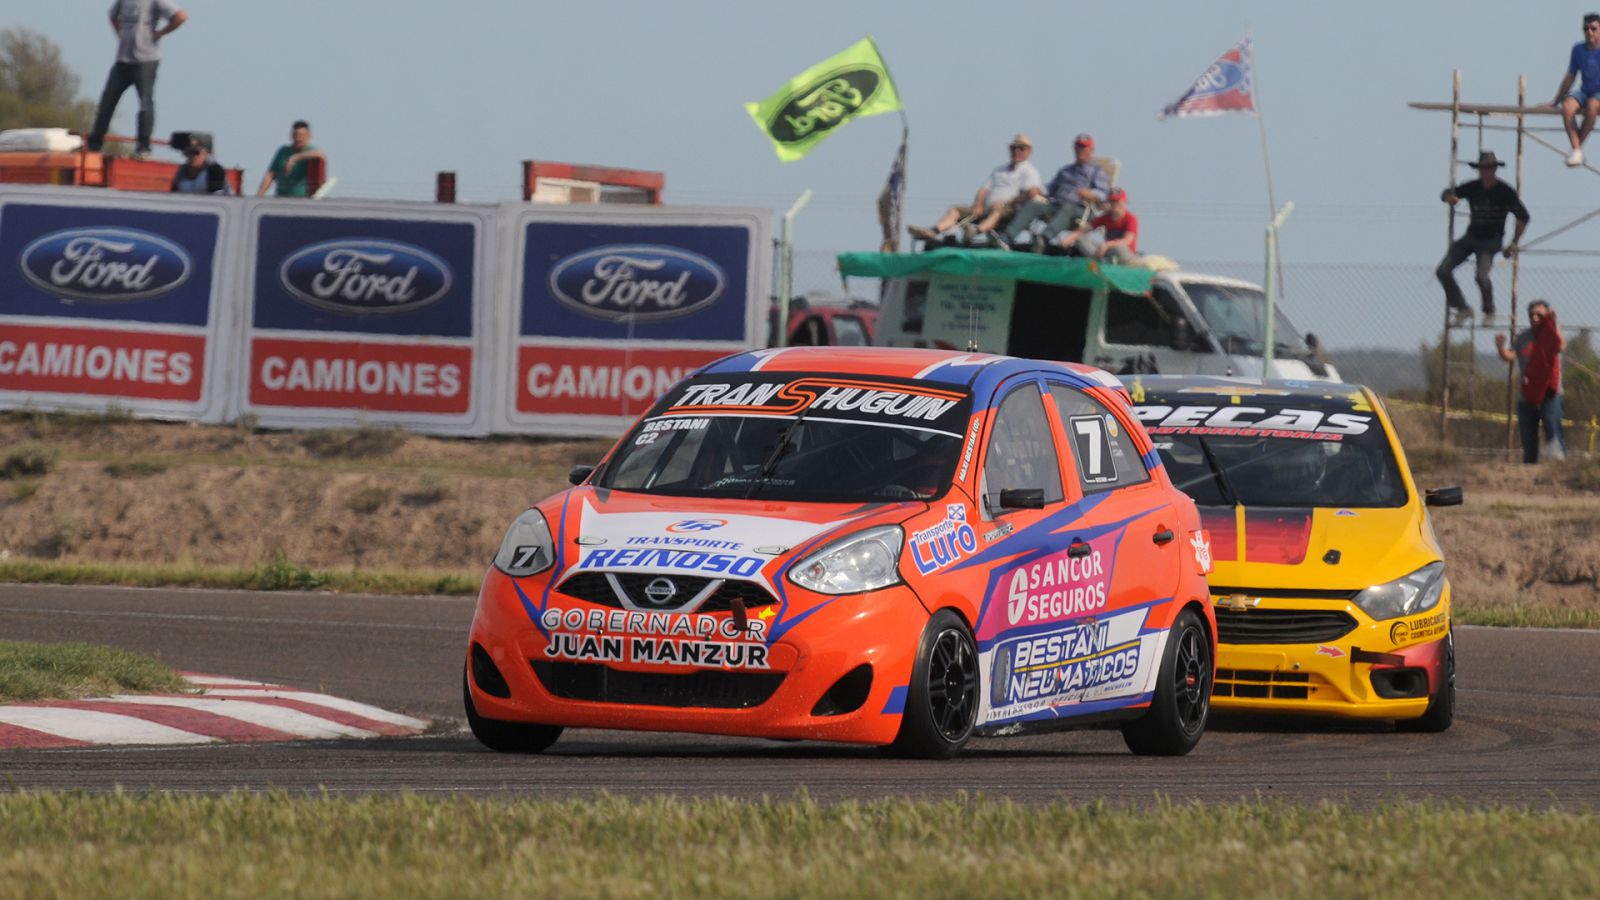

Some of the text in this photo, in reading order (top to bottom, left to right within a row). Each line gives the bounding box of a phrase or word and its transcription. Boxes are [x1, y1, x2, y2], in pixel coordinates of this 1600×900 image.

[52, 236, 159, 289] Ford
[312, 248, 419, 301] Ford
[582, 255, 692, 307] Ford
[0, 340, 192, 385] CAMIONES
[261, 356, 461, 397] CAMIONES
[527, 362, 692, 399] CAMION
[635, 433, 658, 445] C2
[643, 418, 709, 431] BESTANI
[1075, 420, 1102, 475] 7
[626, 536, 744, 550] TRANSPORTE
[910, 524, 976, 575] Luro
[914, 519, 953, 543] Transporte
[512, 547, 538, 568] 7
[579, 548, 765, 577] REINOSO
[1030, 551, 1103, 590] SANCOR
[1028, 581, 1105, 621] SEGUROS
[541, 609, 766, 641] GOBERNADOR
[545, 634, 768, 667] JUAN MANZUR
[1014, 625, 1108, 667] BESTANI
[1010, 648, 1137, 700] NEUMATICOS
